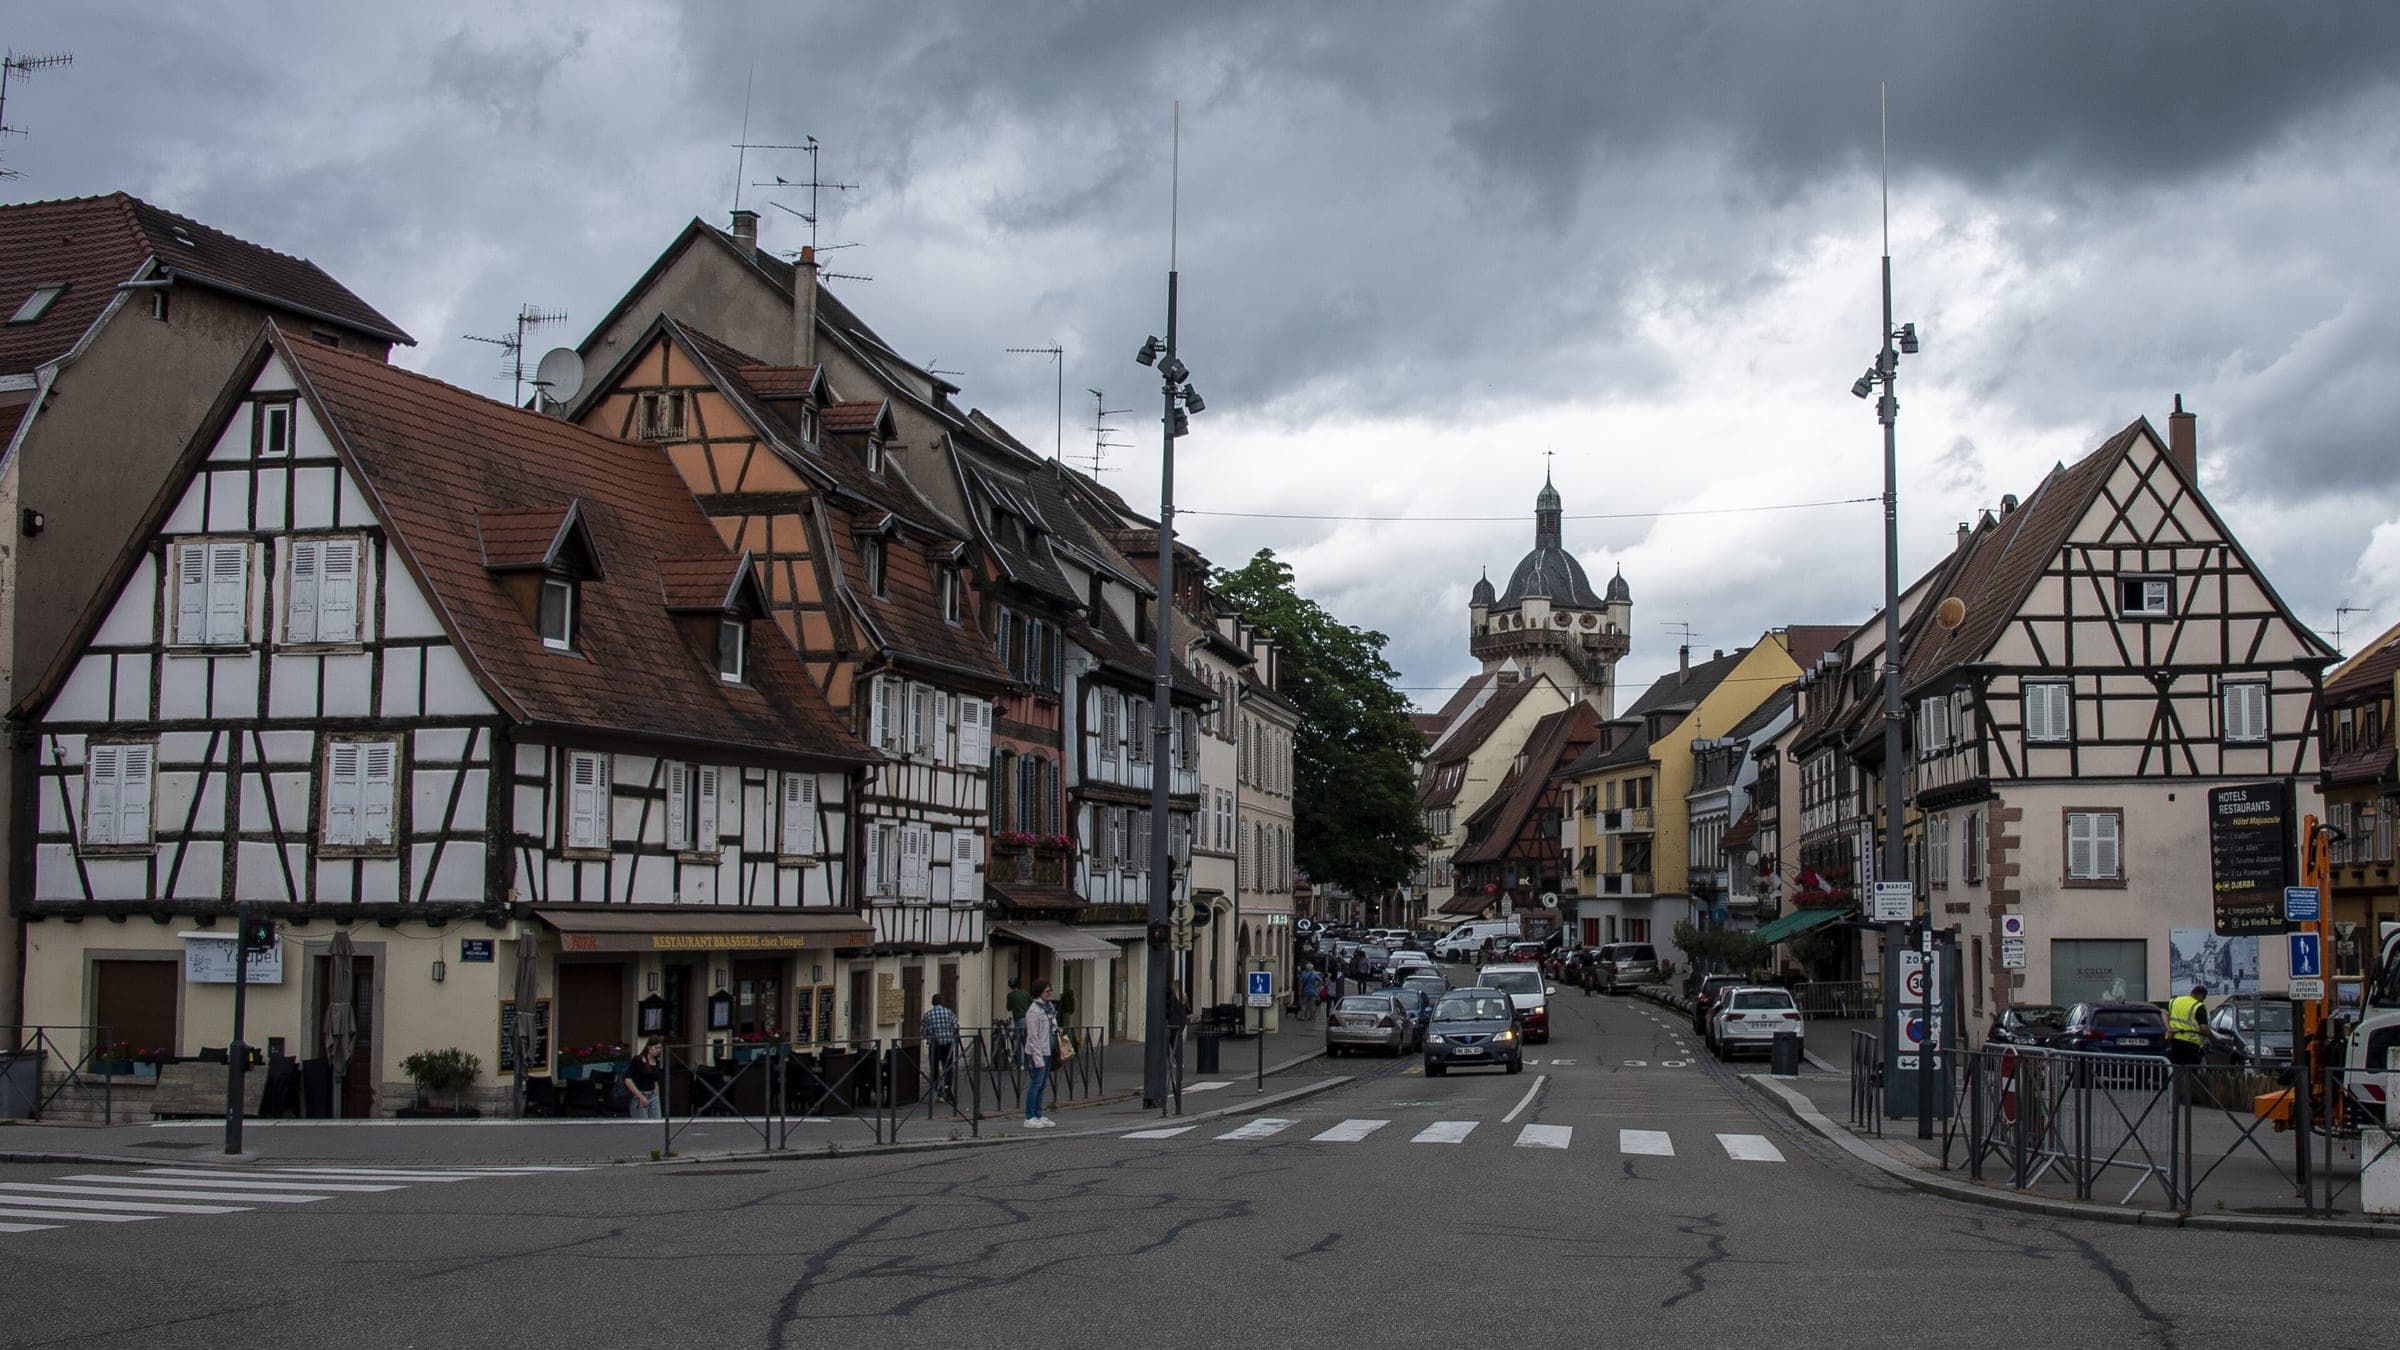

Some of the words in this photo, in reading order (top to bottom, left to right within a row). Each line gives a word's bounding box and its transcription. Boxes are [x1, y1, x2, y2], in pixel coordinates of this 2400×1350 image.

[2218, 791, 2248, 802] HOTELS
[2219, 801, 2271, 815] RESTAURANTS
[2231, 880, 2255, 889] DJERBA
[653, 935, 713, 948] RESTAURANT
[714, 935, 760, 947] BRASSERIE
